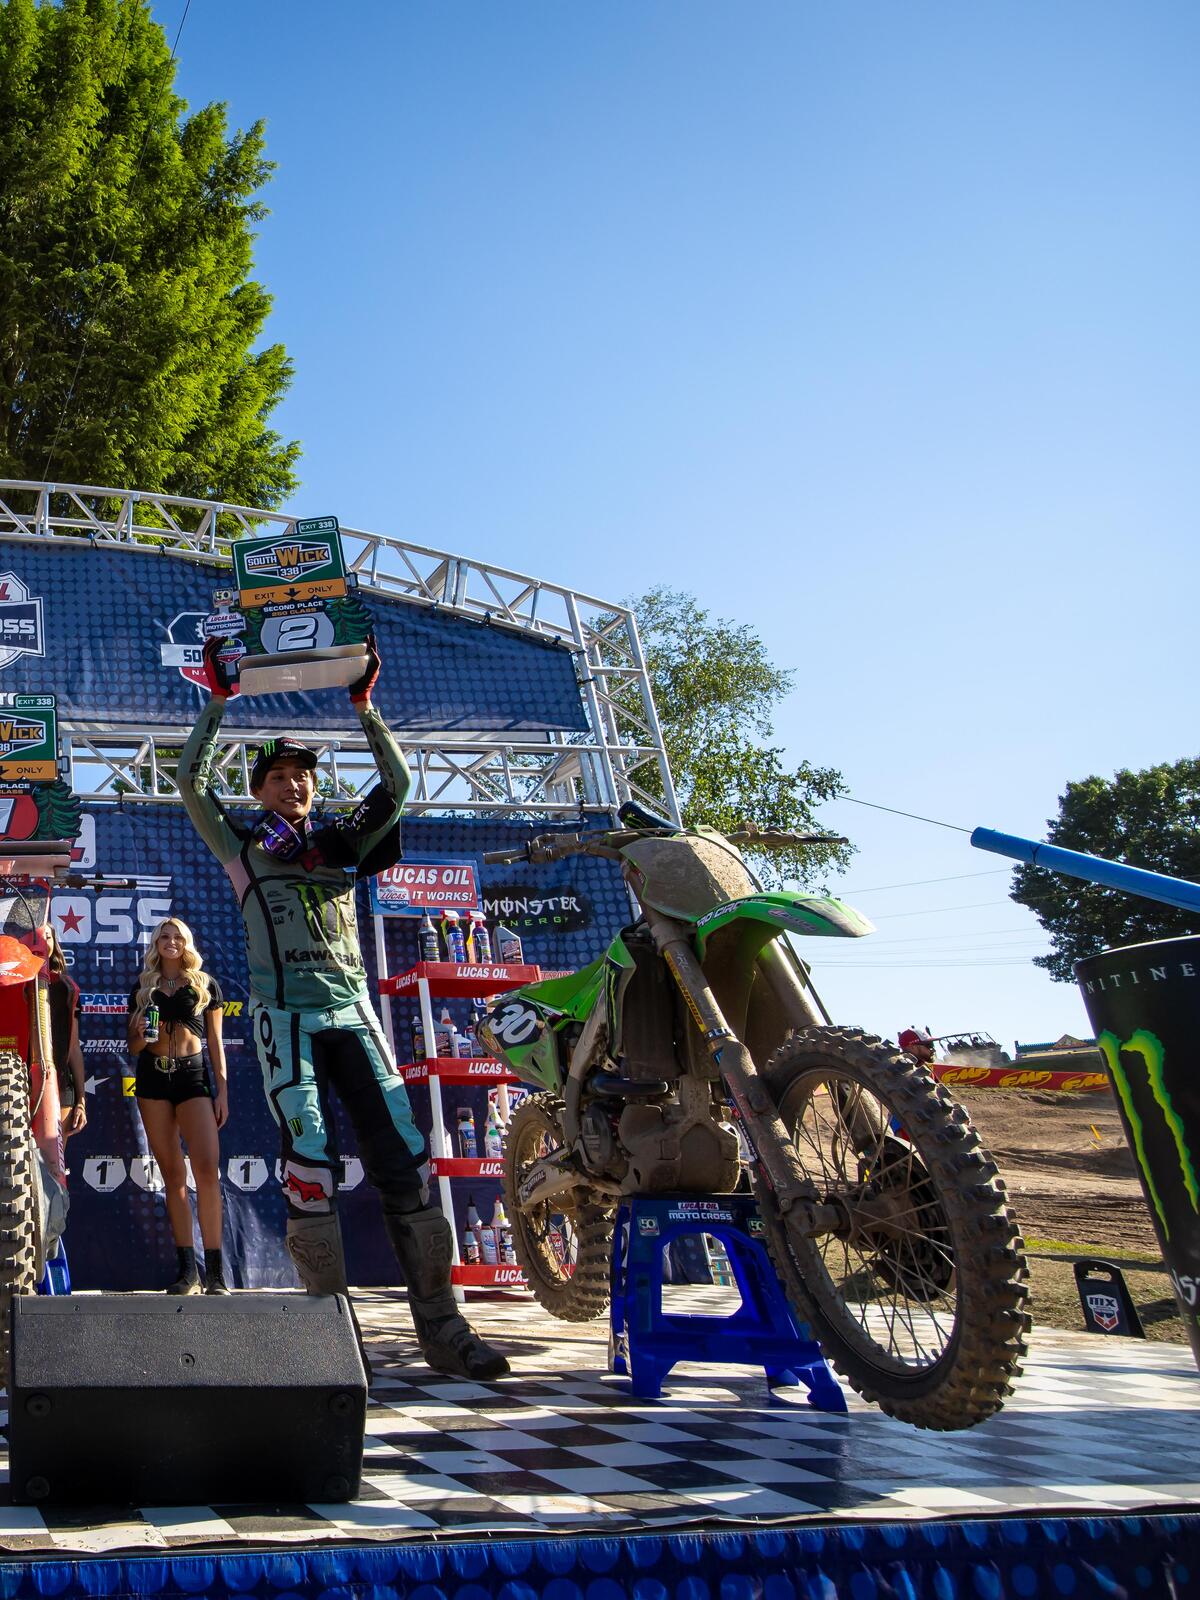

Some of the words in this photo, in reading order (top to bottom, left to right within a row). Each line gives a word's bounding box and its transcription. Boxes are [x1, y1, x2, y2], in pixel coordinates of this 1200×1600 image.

[318, 521, 333, 529] 338
[280, 567, 300, 576] 338
[214, 590, 230, 600] 50
[254, 592, 276, 600] EXIT
[307, 585, 334, 594] ONLY
[263, 603, 296, 613] SECOND
[296, 600, 324, 609] PLACE
[289, 607, 317, 615] CLASS
[206, 621, 244, 630] MOTOCROSS
[210, 615, 228, 623] LUCAS
[277, 617, 318, 651] 2
[36, 697, 52, 705] 338
[16, 766, 43, 774] ONLY
[261, 822, 287, 843] SCOTT
[381, 867, 438, 885] LUCAS
[442, 868, 470, 886] OIL
[380, 892, 407, 900] LUCAS
[412, 890, 424, 900] IT
[426, 891, 473, 903] WORKS!
[483, 896, 582, 917] MONSTER
[696, 910, 714, 928] RO
[456, 965, 490, 979] LUCAS
[395, 973, 411, 990] LUCAS
[488, 1003, 538, 1045] 30
[87, 1039, 128, 1048] DUNL
[405, 1066, 421, 1079] LUCAS
[468, 1062, 503, 1075] LUCAS
[941, 1067, 989, 1084] FMF
[999, 1071, 1051, 1087] FMF
[1061, 1073, 1109, 1090] FM
[95, 1160, 116, 1185] 1ST
[239, 1160, 257, 1185] 1ST
[680, 1201, 705, 1210] LUCAS
[705, 1201, 719, 1210] OIL
[639, 1218, 656, 1229] 50
